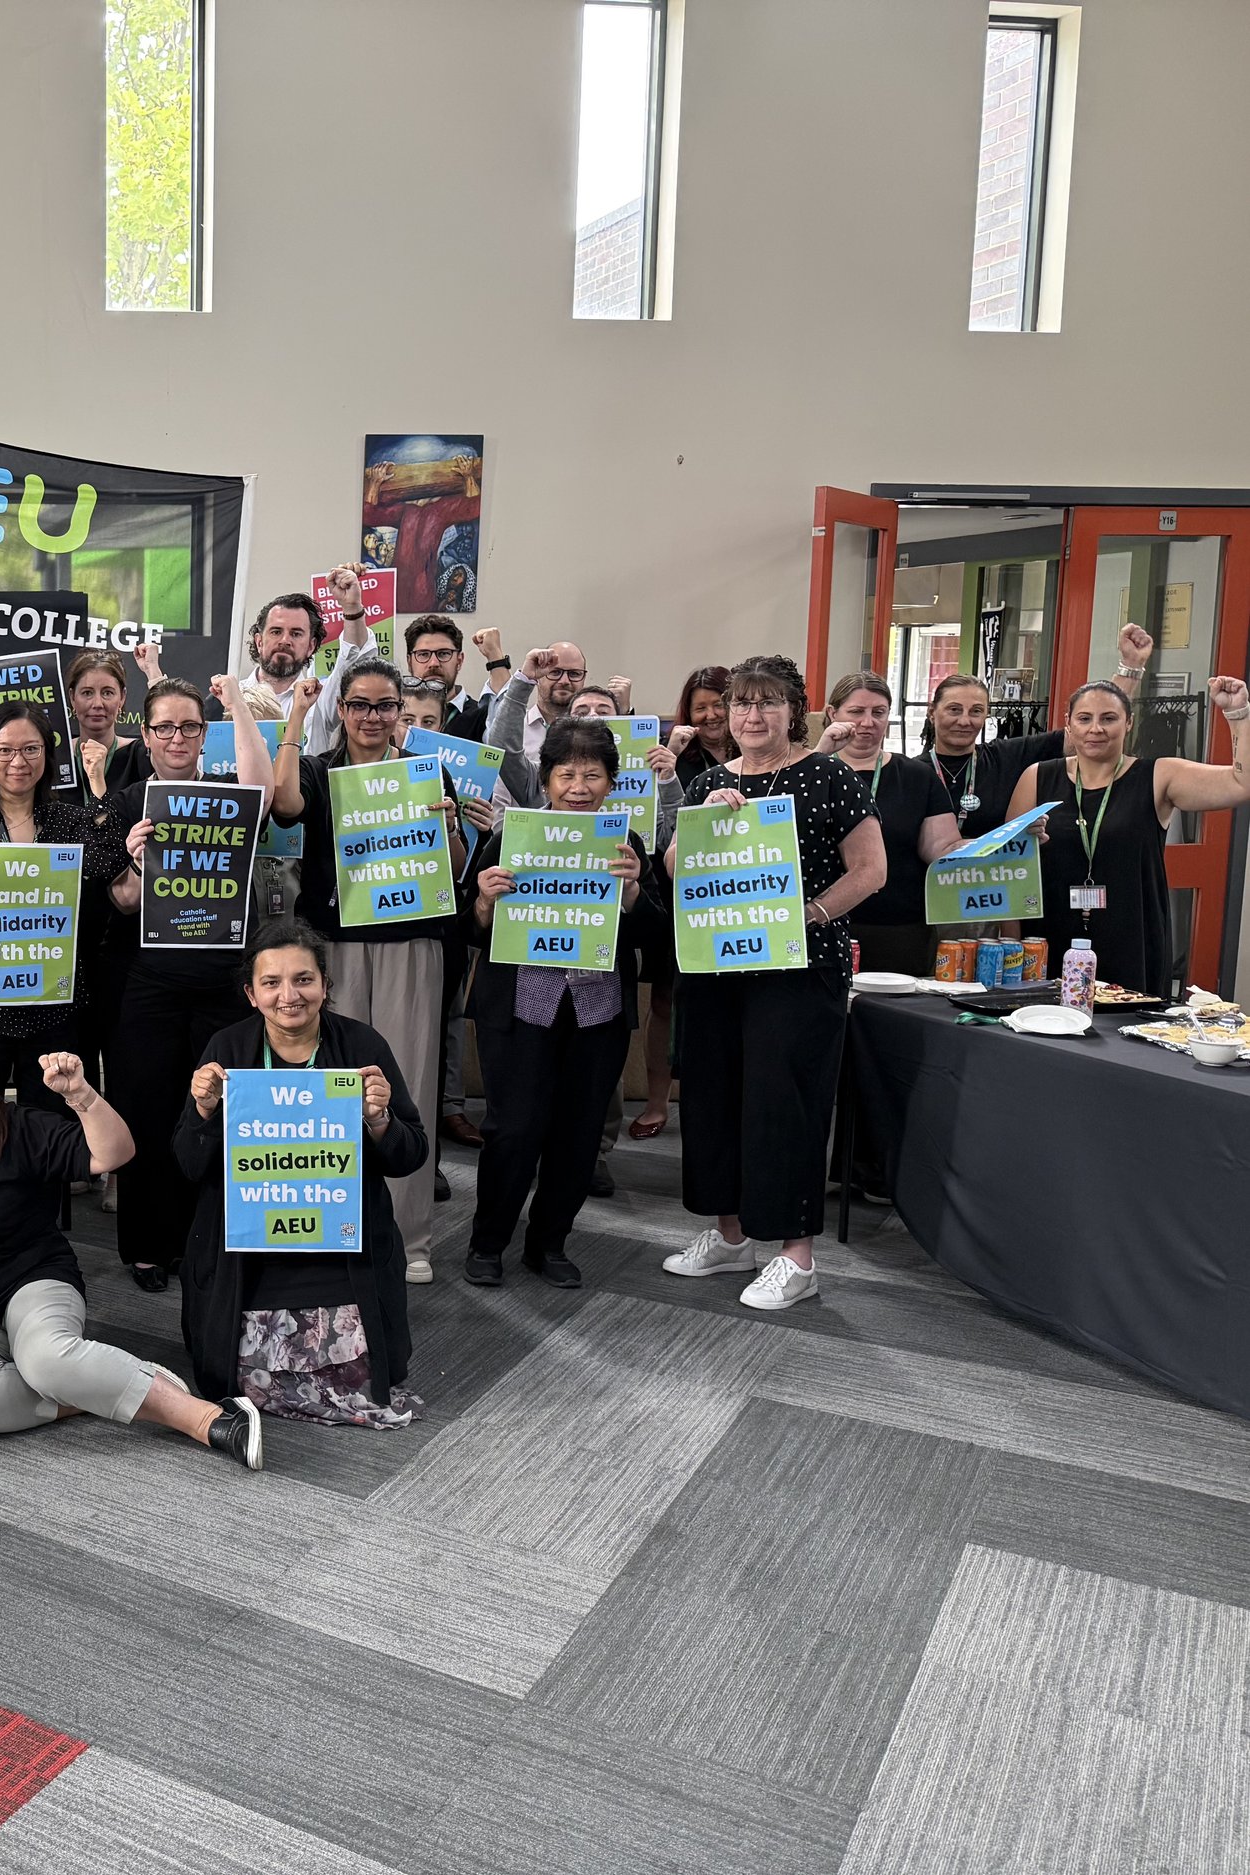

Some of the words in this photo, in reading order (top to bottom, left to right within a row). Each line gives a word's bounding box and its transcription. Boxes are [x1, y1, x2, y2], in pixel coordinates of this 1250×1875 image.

[1162, 516, 1174, 524] Y16
[318, 578, 378, 598] BLED
[438, 746, 467, 766] We
[485, 751, 499, 761] IEU
[626, 753, 644, 768] in
[416, 763, 433, 772] IEU
[364, 778, 399, 795] We
[464, 778, 482, 798] in
[167, 796, 240, 819] WE’D
[342, 804, 403, 827] stand
[408, 801, 430, 819] in
[767, 804, 785, 814] IEU
[603, 820, 622, 828] IEU
[712, 818, 749, 837] We
[154, 822, 246, 846] STRIKE
[344, 829, 436, 856] solidarity
[544, 826, 583, 842] We
[58, 853, 75, 861] IEU
[162, 850, 184, 870] IF
[190, 850, 232, 871] WE
[510, 852, 581, 869] stand
[586, 853, 608, 870] in
[684, 846, 753, 869] stand
[759, 843, 782, 863] in
[5, 861, 40, 877] We
[348, 862, 396, 882] with
[400, 860, 438, 877] the
[937, 868, 984, 885] with
[990, 866, 1027, 881] the
[44, 887, 64, 904] in
[153, 877, 238, 898] COULD
[510, 878, 611, 899] solidarity
[684, 874, 789, 900] solidarity
[378, 890, 415, 909] AEU
[965, 893, 1002, 909] AEU
[170, 916, 202, 924] education
[507, 904, 559, 923] with
[565, 908, 605, 926] the
[688, 907, 742, 928] with
[748, 906, 790, 924] the
[28, 943, 63, 960] the
[533, 937, 574, 952] AEU
[721, 938, 762, 957] AEU
[2, 973, 38, 989] AEU
[335, 1078, 355, 1086] IEU
[271, 1087, 313, 1106] We
[238, 1119, 314, 1138] stand
[321, 1118, 345, 1138] in
[238, 1150, 350, 1173] solidarity
[240, 1182, 298, 1202] with
[304, 1184, 347, 1203] the
[272, 1218, 315, 1234] AEU
